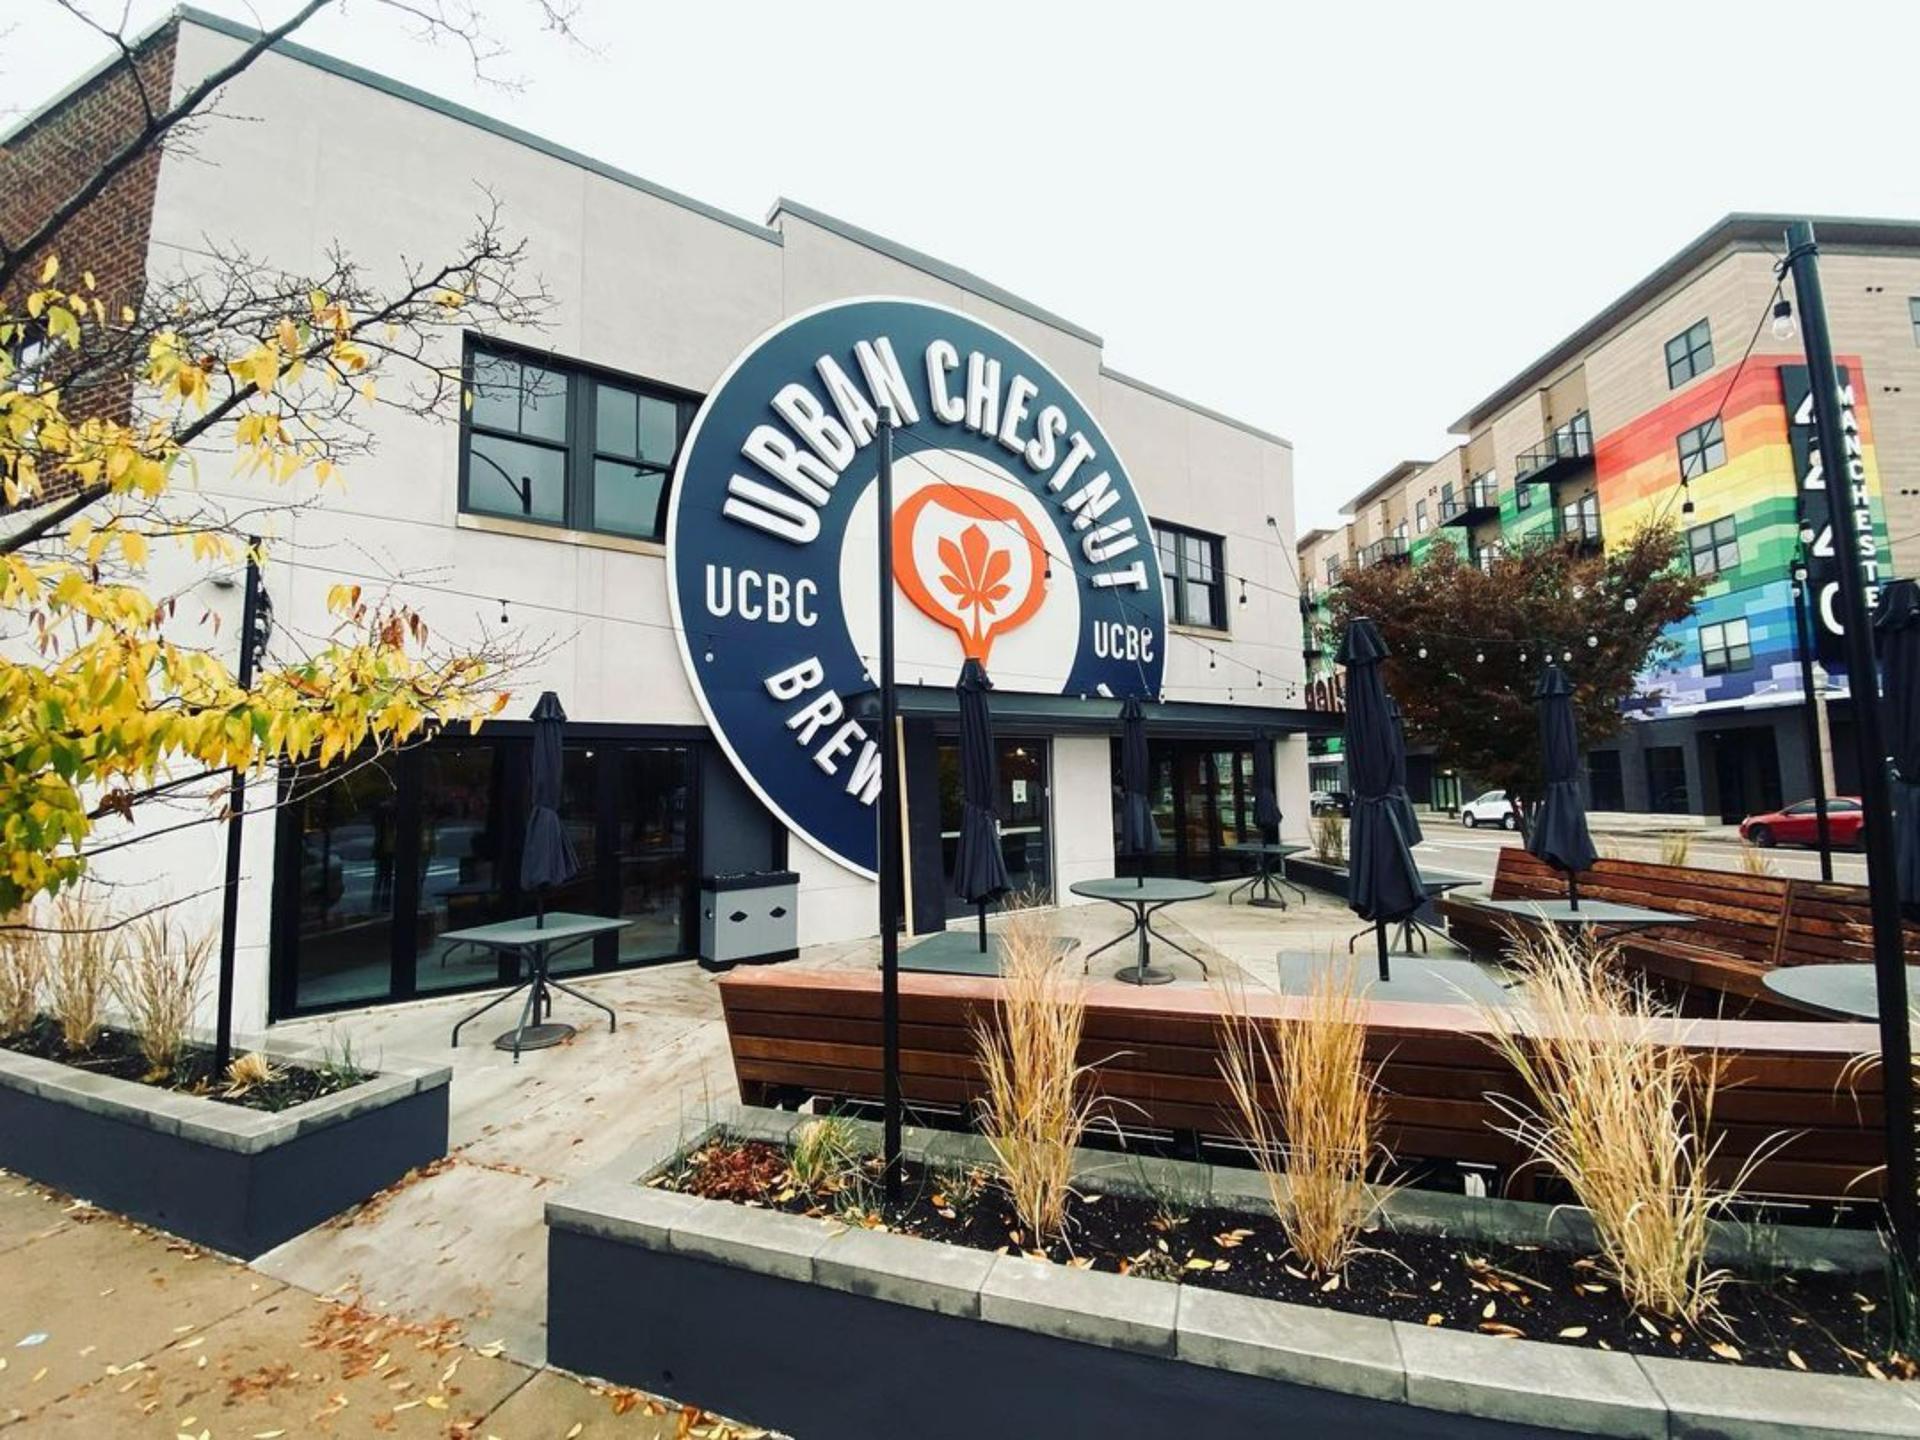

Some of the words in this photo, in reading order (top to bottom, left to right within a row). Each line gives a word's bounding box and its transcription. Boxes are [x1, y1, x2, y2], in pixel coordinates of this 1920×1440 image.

[722, 336, 921, 545] URBAN
[924, 338, 1149, 593] CHESTNUT
[1838, 384, 1880, 617] MANCHESTE
[704, 564, 819, 627] UCBC
[1094, 620, 1155, 663] UCBC
